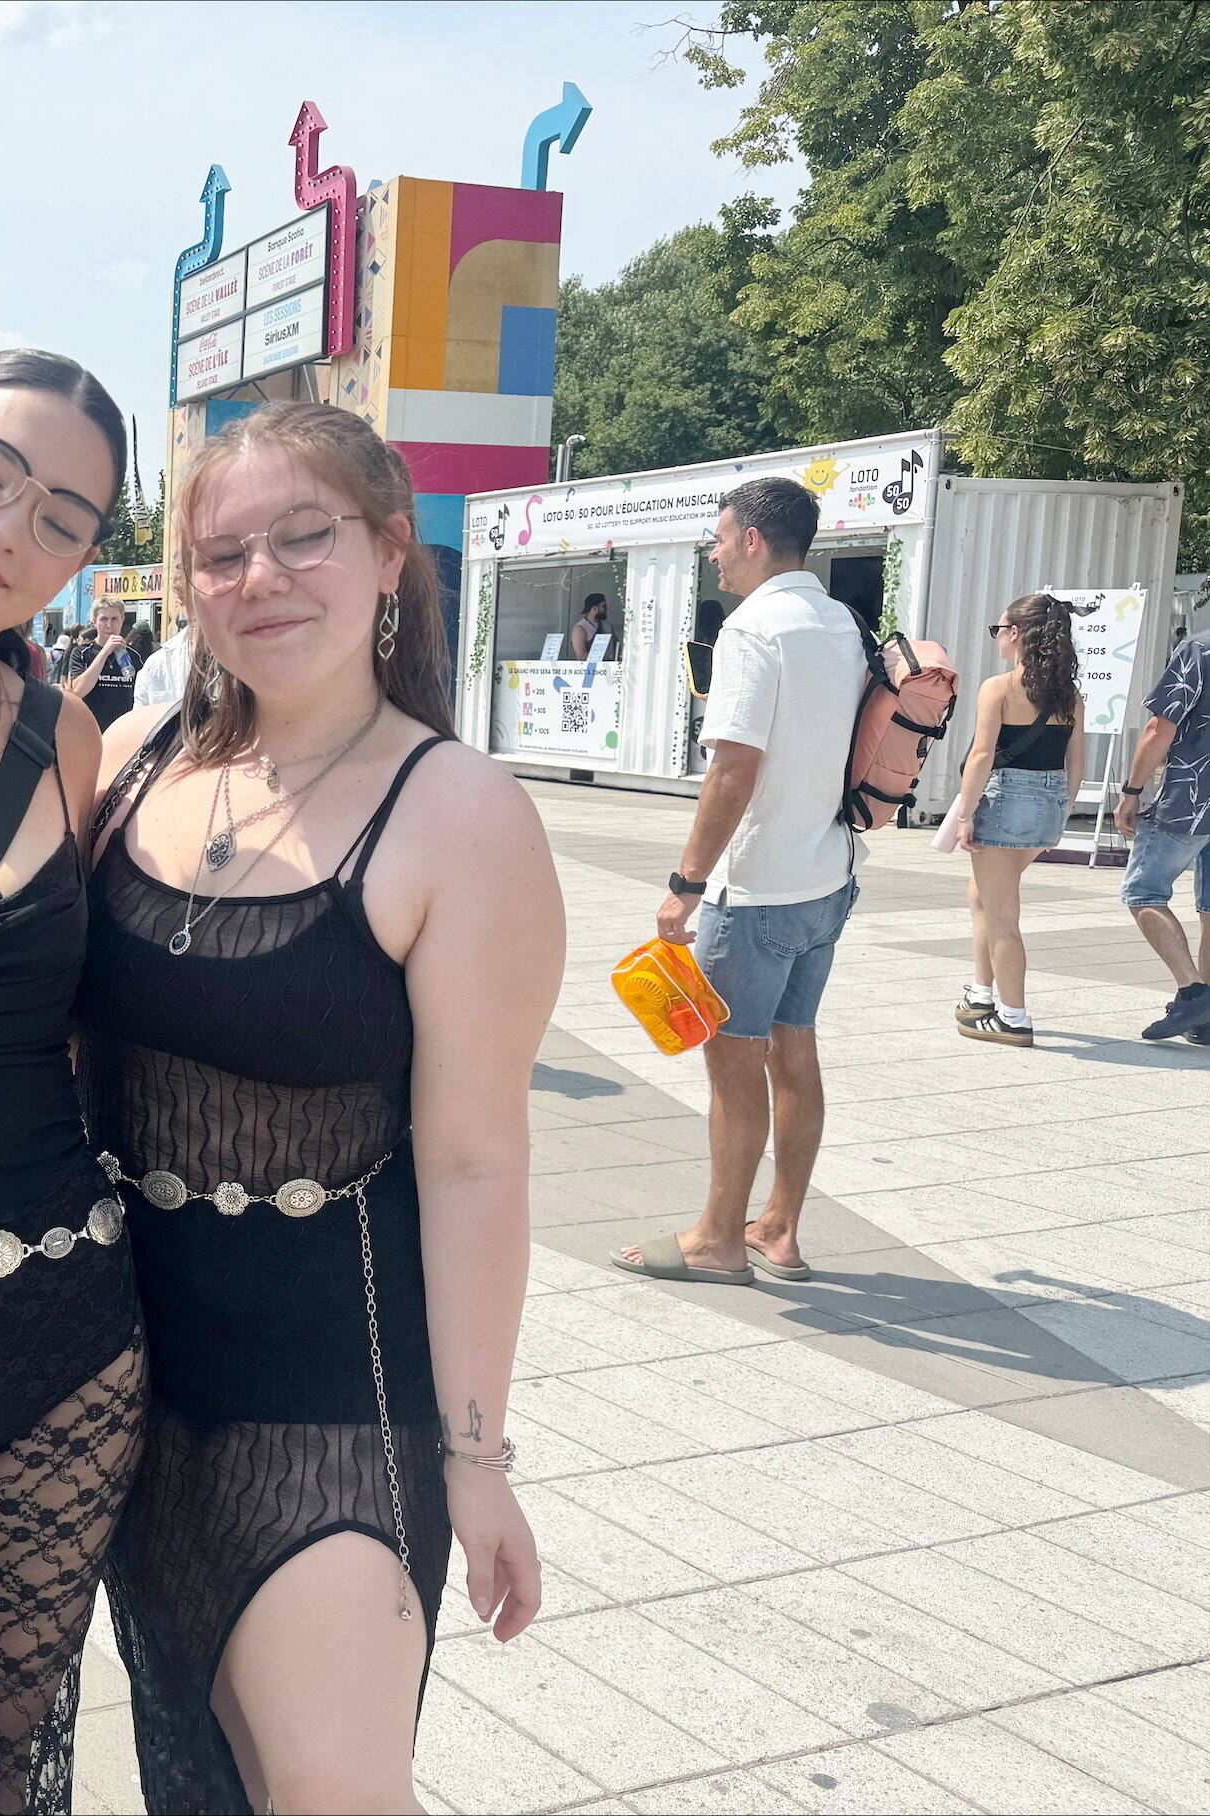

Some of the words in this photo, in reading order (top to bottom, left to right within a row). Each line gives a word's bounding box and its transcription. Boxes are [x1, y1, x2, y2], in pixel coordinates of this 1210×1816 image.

[267, 236, 287, 252] Banque
[288, 227, 304, 242] Scotia
[275, 257, 283, 273] DE
[283, 253, 290, 270] LA
[291, 241, 314, 266] FORÊT
[201, 293, 208, 309] DE
[207, 290, 215, 306] LA
[263, 310, 274, 326] LES
[274, 298, 301, 322] SESSIONS
[264, 321, 300, 346] SiriusXM
[205, 356, 212, 372] DE
[851, 468, 879, 484] LOTO
[849, 484, 878, 493] fondation
[886, 484, 900, 498] 50
[542, 510, 563, 523] LOTO
[590, 504, 614, 518] POUR
[615, 497, 674, 516] L'ÉDUCATION
[896, 496, 909, 510] 50
[471, 516, 488, 528] LOTO
[601, 520, 621, 529] LOTTERY
[630, 517, 652, 526] SUPPORT
[669, 512, 699, 522] EDUCATION
[104, 576, 129, 594] LIMO
[131, 576, 138, 592] &
[1086, 624, 1107, 633] 20$
[1086, 647, 1106, 655] 50$
[1087, 672, 1112, 681] 100$
